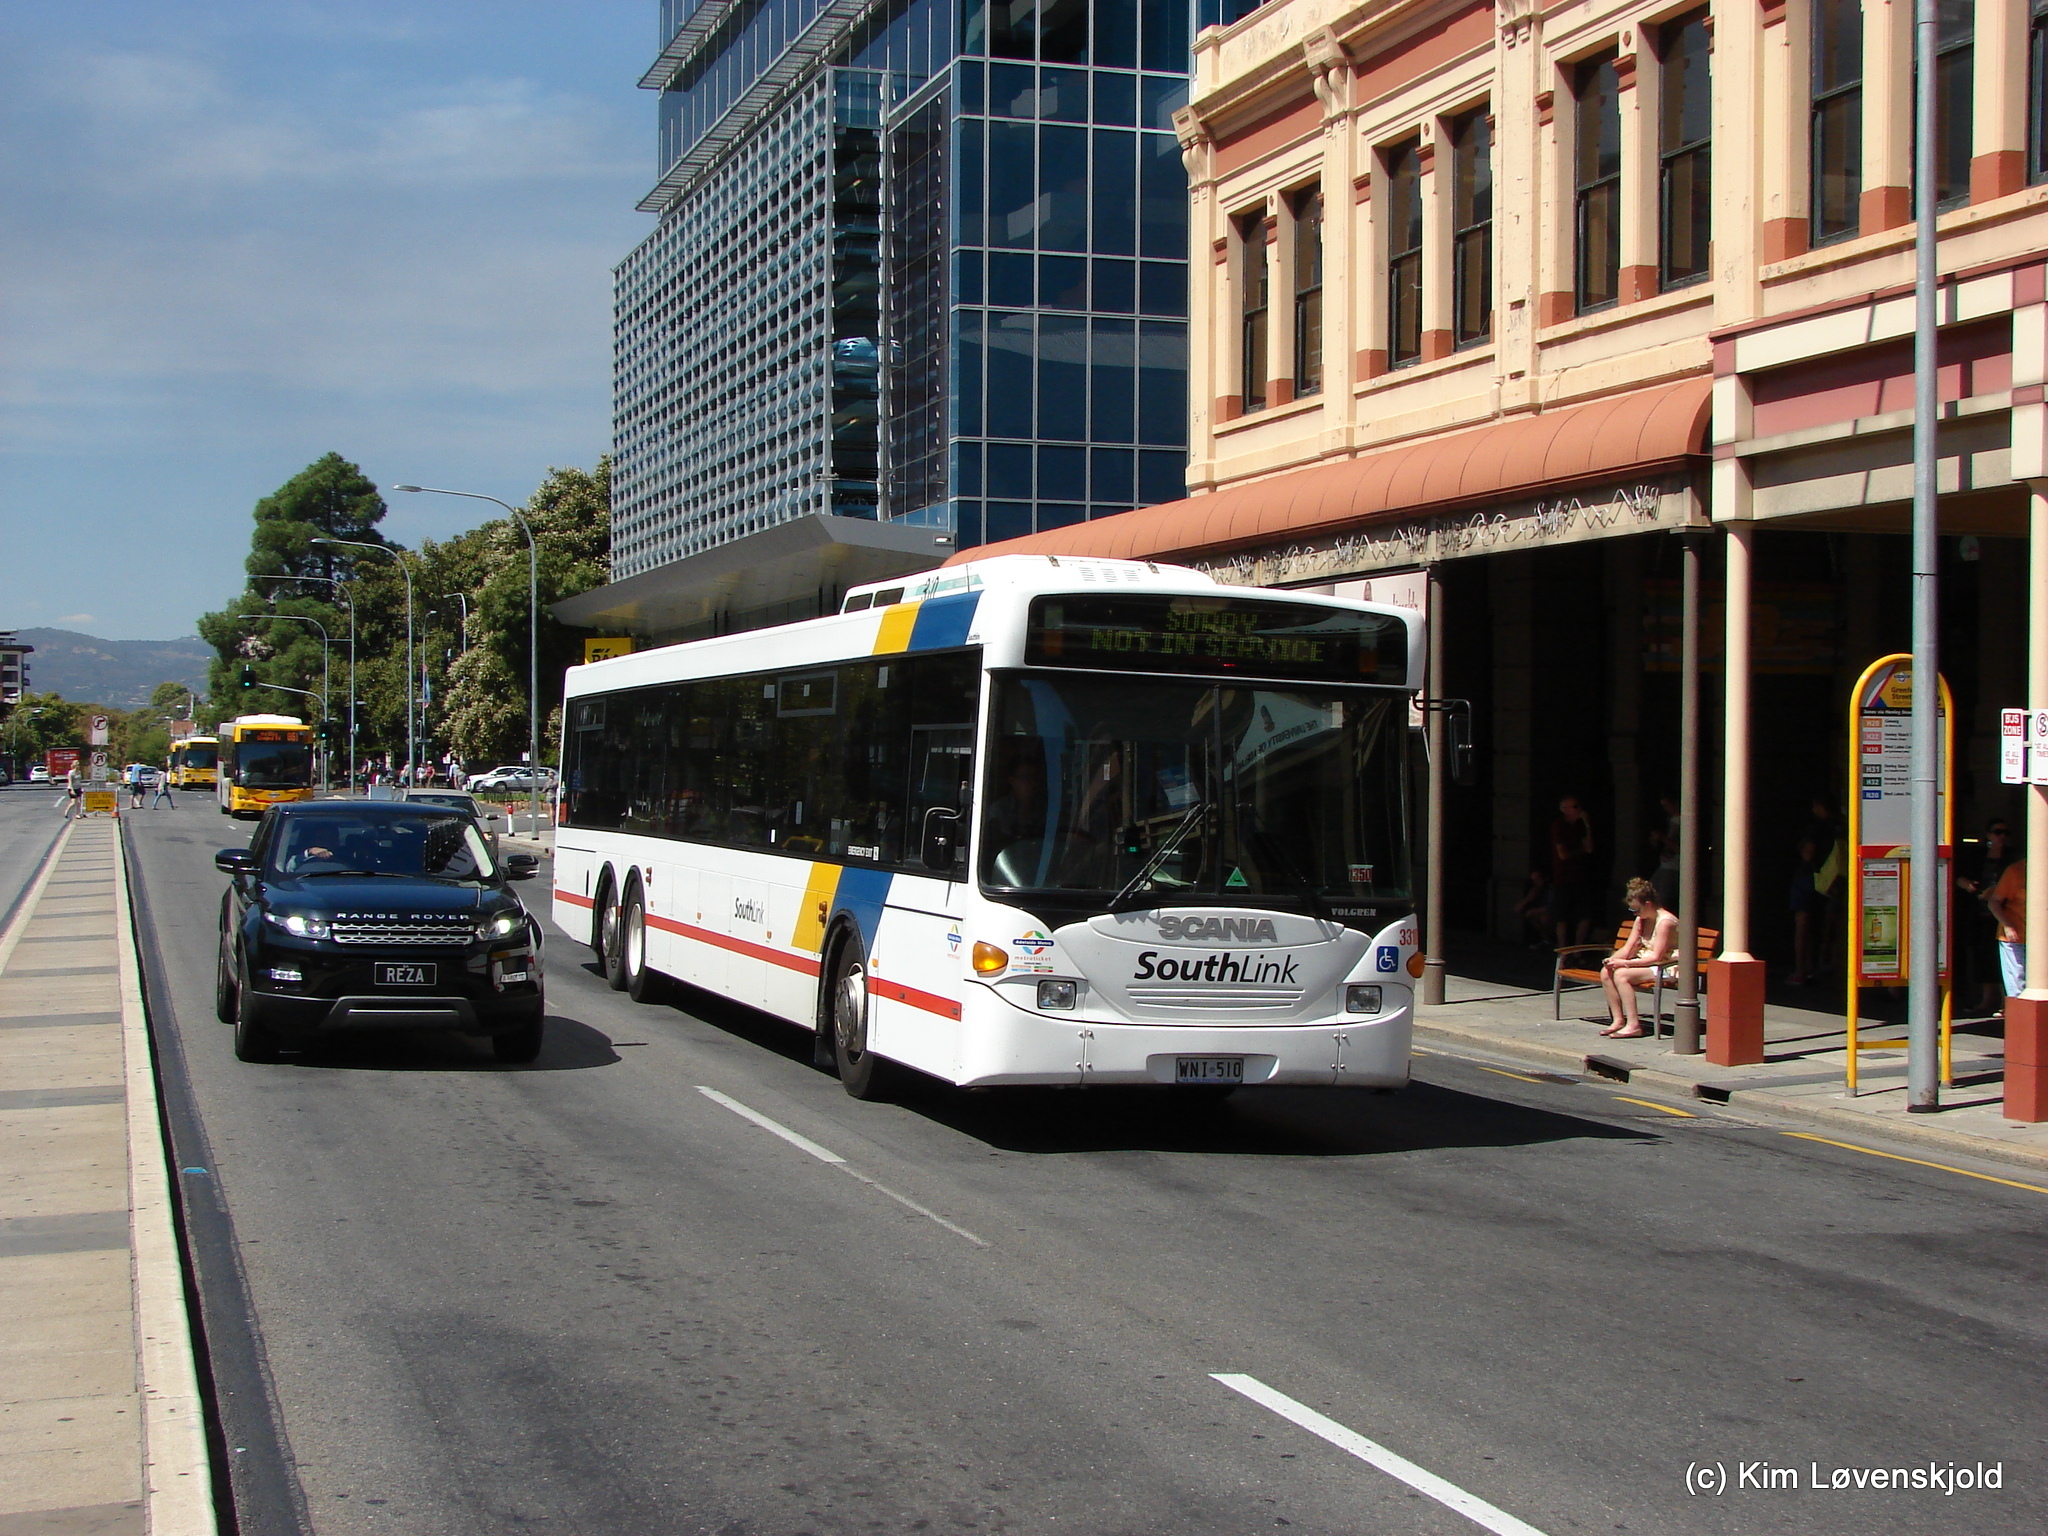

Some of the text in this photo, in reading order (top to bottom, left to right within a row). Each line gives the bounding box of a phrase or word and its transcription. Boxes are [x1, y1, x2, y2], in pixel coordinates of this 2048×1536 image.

[1166, 611, 1258, 634] SORRY
[1090, 628, 1326, 663] NOT IN SERVICE
[2004, 714, 2020, 724] BUS
[2003, 725, 2022, 736] ZONE
[336, 912, 399, 920] RANGE
[734, 897, 765, 925] SouthLink
[1330, 907, 1377, 917] VOLGREN
[1158, 916, 1278, 943] SCANIA
[386, 968, 425, 983] REZA
[1134, 951, 1300, 984] SouthLink
